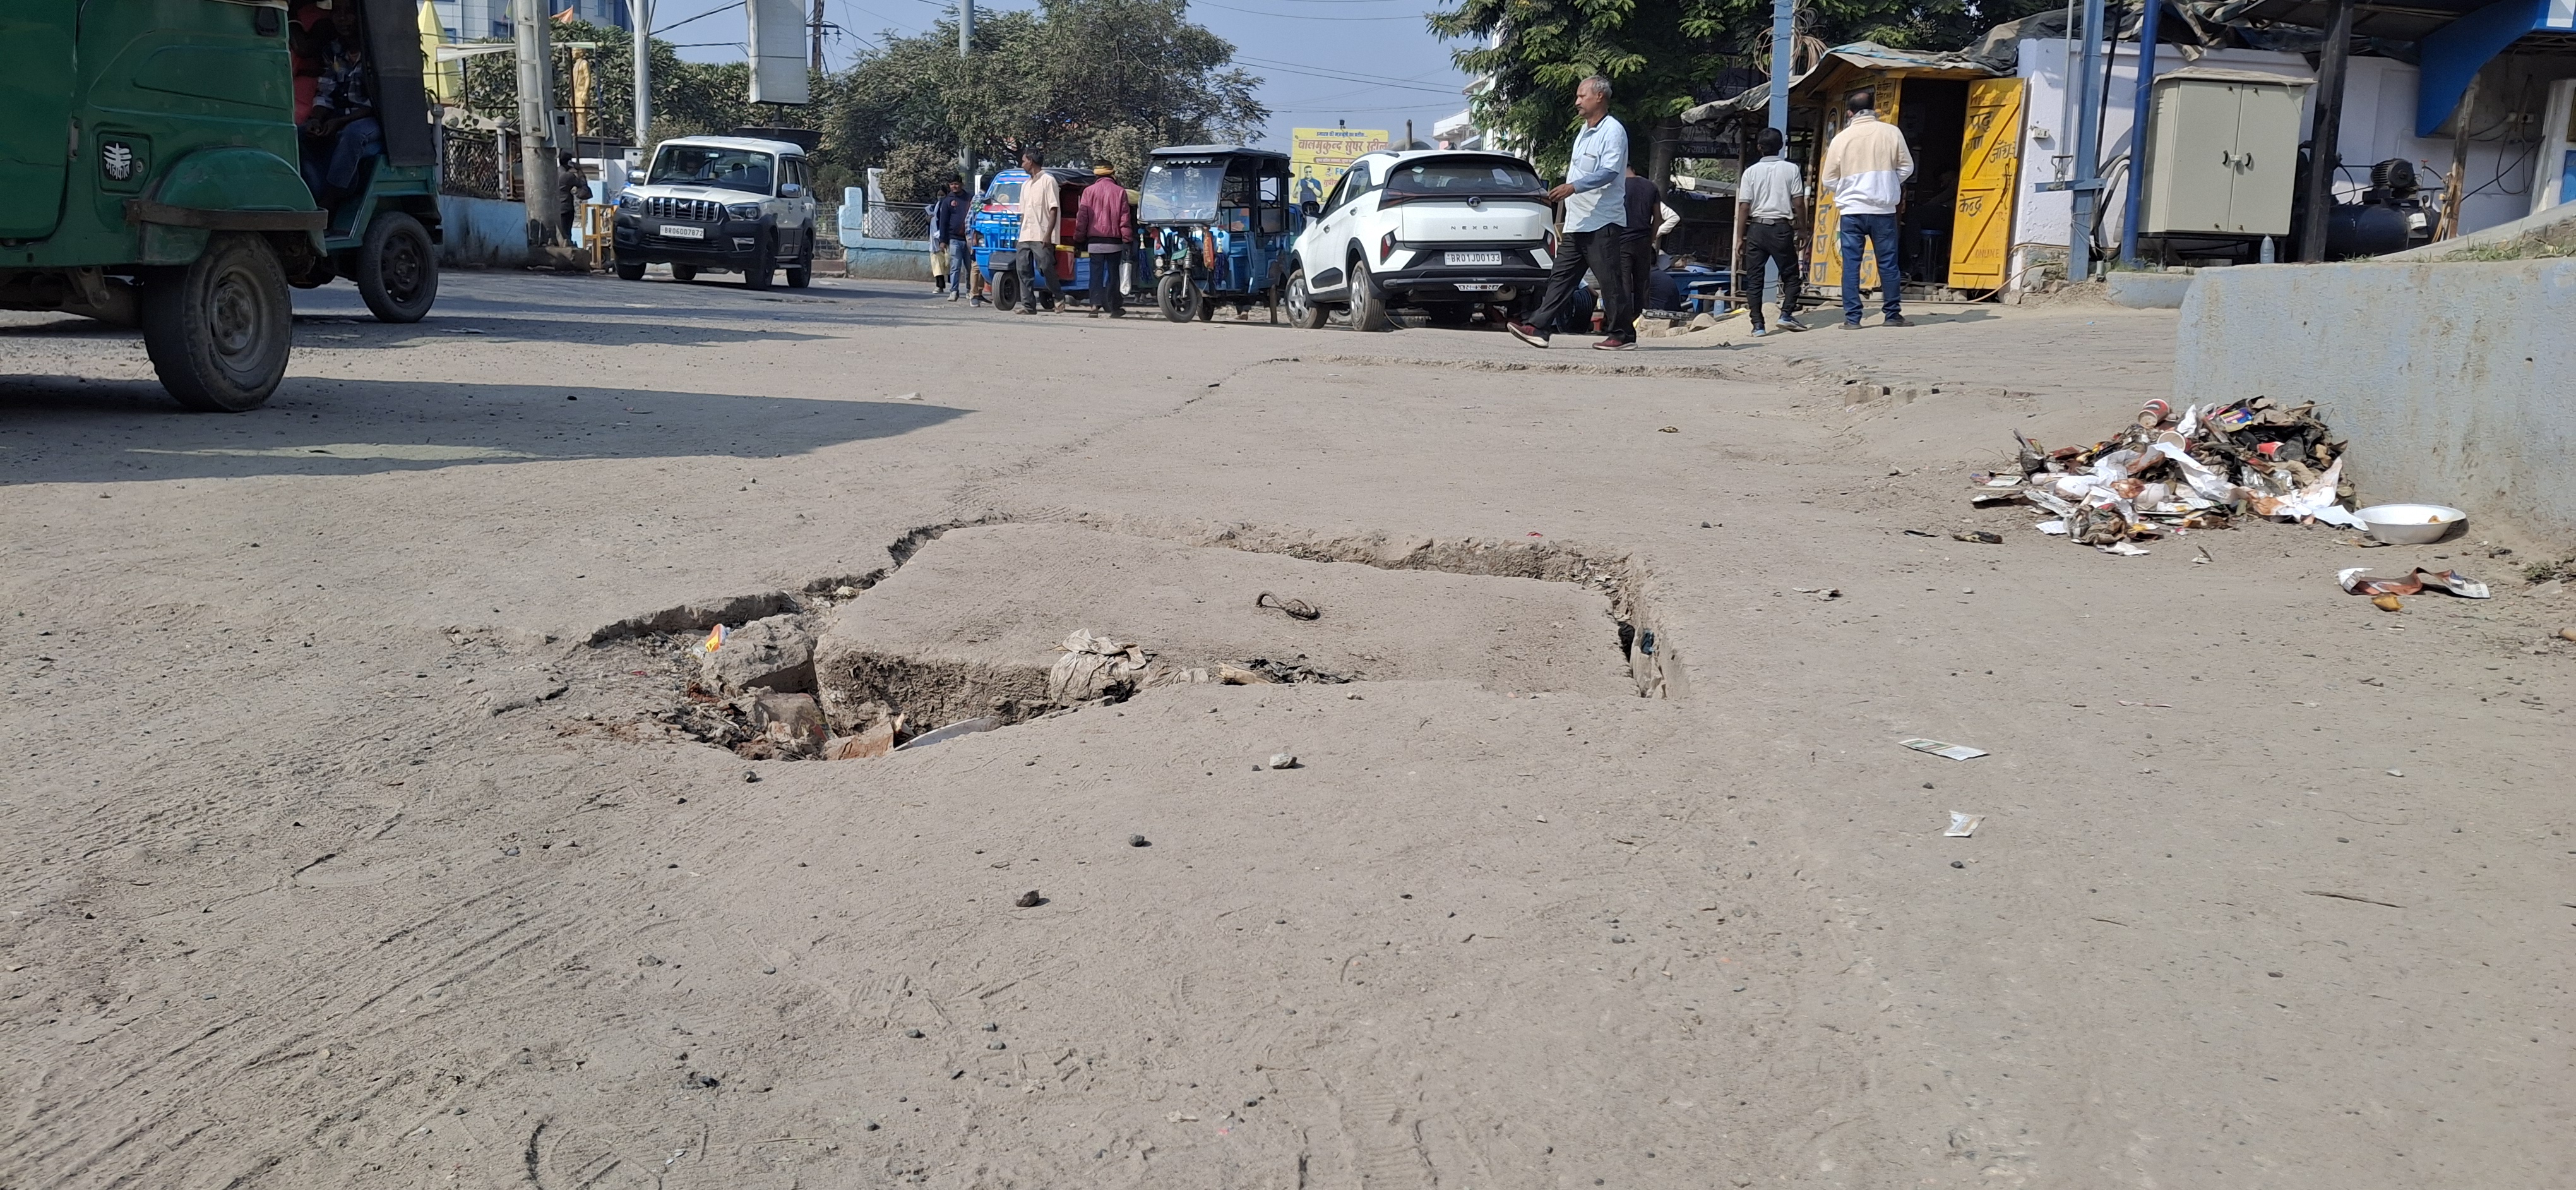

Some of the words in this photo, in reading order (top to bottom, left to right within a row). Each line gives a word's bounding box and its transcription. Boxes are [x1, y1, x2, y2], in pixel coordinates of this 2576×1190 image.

[1345, 140, 1364, 155] सुपर
[1959, 193, 1984, 217] केन्द्र
[1451, 254, 1500, 262] BR01JD0133
[1974, 248, 2000, 258] ONLINE
